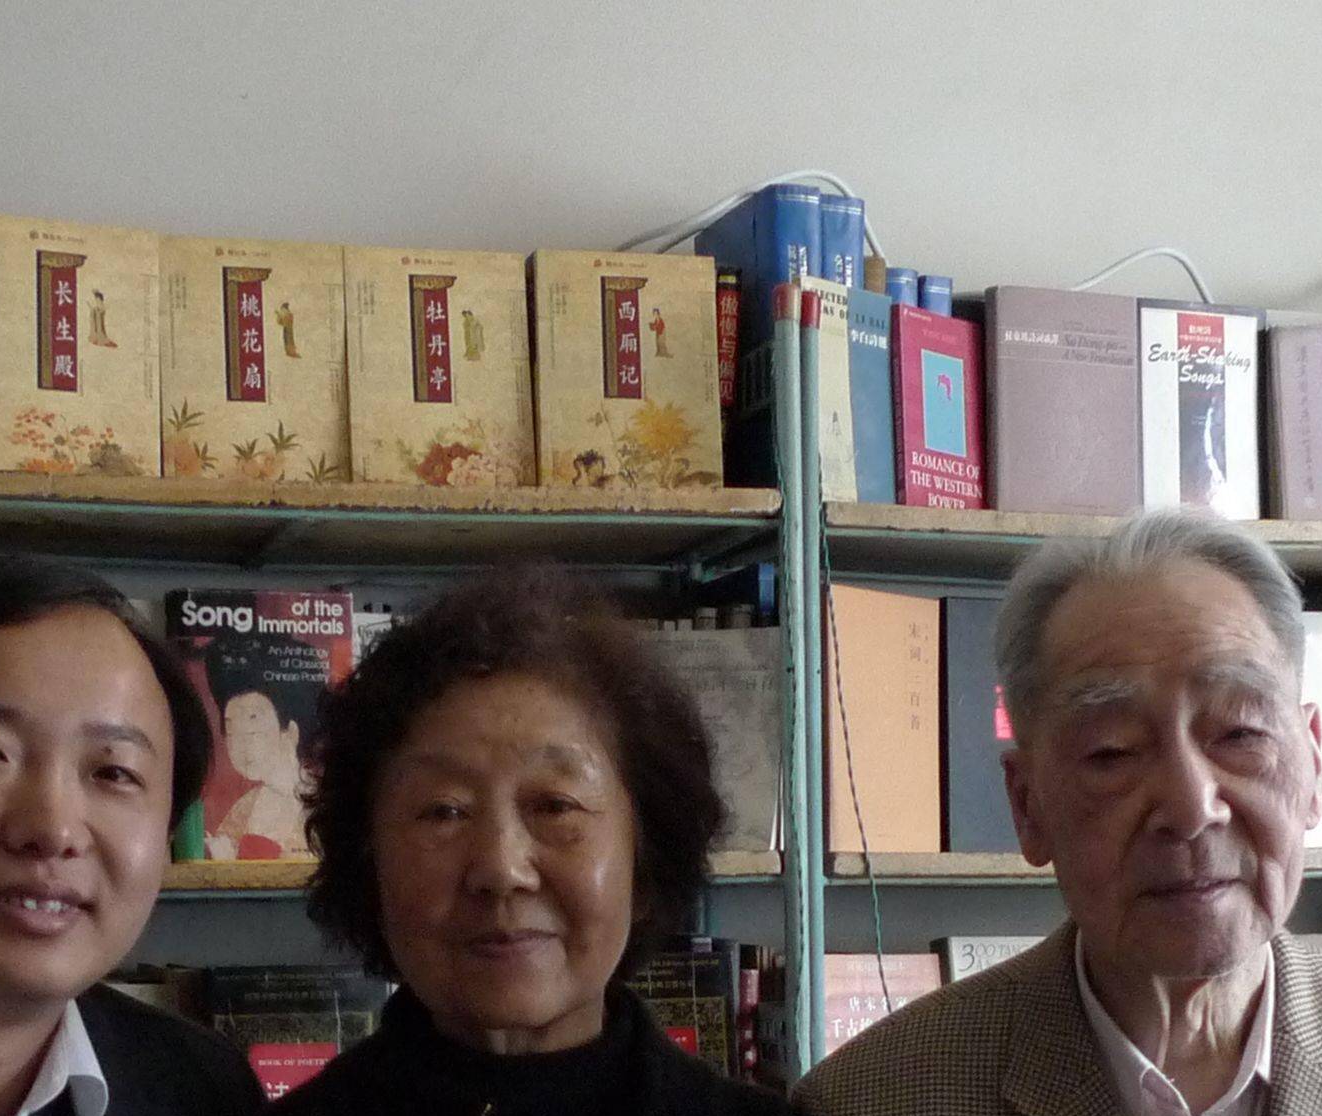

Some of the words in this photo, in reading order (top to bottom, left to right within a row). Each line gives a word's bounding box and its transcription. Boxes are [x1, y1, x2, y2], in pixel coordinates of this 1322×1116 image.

[53, 279, 76, 379] 长生殿
[240, 292, 264, 389] 桃花扇
[617, 300, 639, 385] 西厢记
[426, 299, 448, 391] 牡丹亭
[1148, 343, 1252, 372] Earth-Shaking
[1179, 363, 1225, 390] Songs
[911, 450, 964, 477] ROMANCE
[966, 465, 981, 480] OF
[910, 469, 932, 488] THE
[933, 472, 982, 499] WESTERN
[928, 493, 966, 510] BOWER
[181, 600, 255, 634] Song
[292, 600, 311, 616] of
[315, 599, 343, 616] the
[258, 616, 345, 635] Immortals
[283, 646, 330, 660] Anthology
[263, 671, 299, 682] Chinese
[908, 621, 921, 731] 宋词三百首
[258, 1059, 282, 1067] BOOK
[284, 1058, 295, 1067] OF
